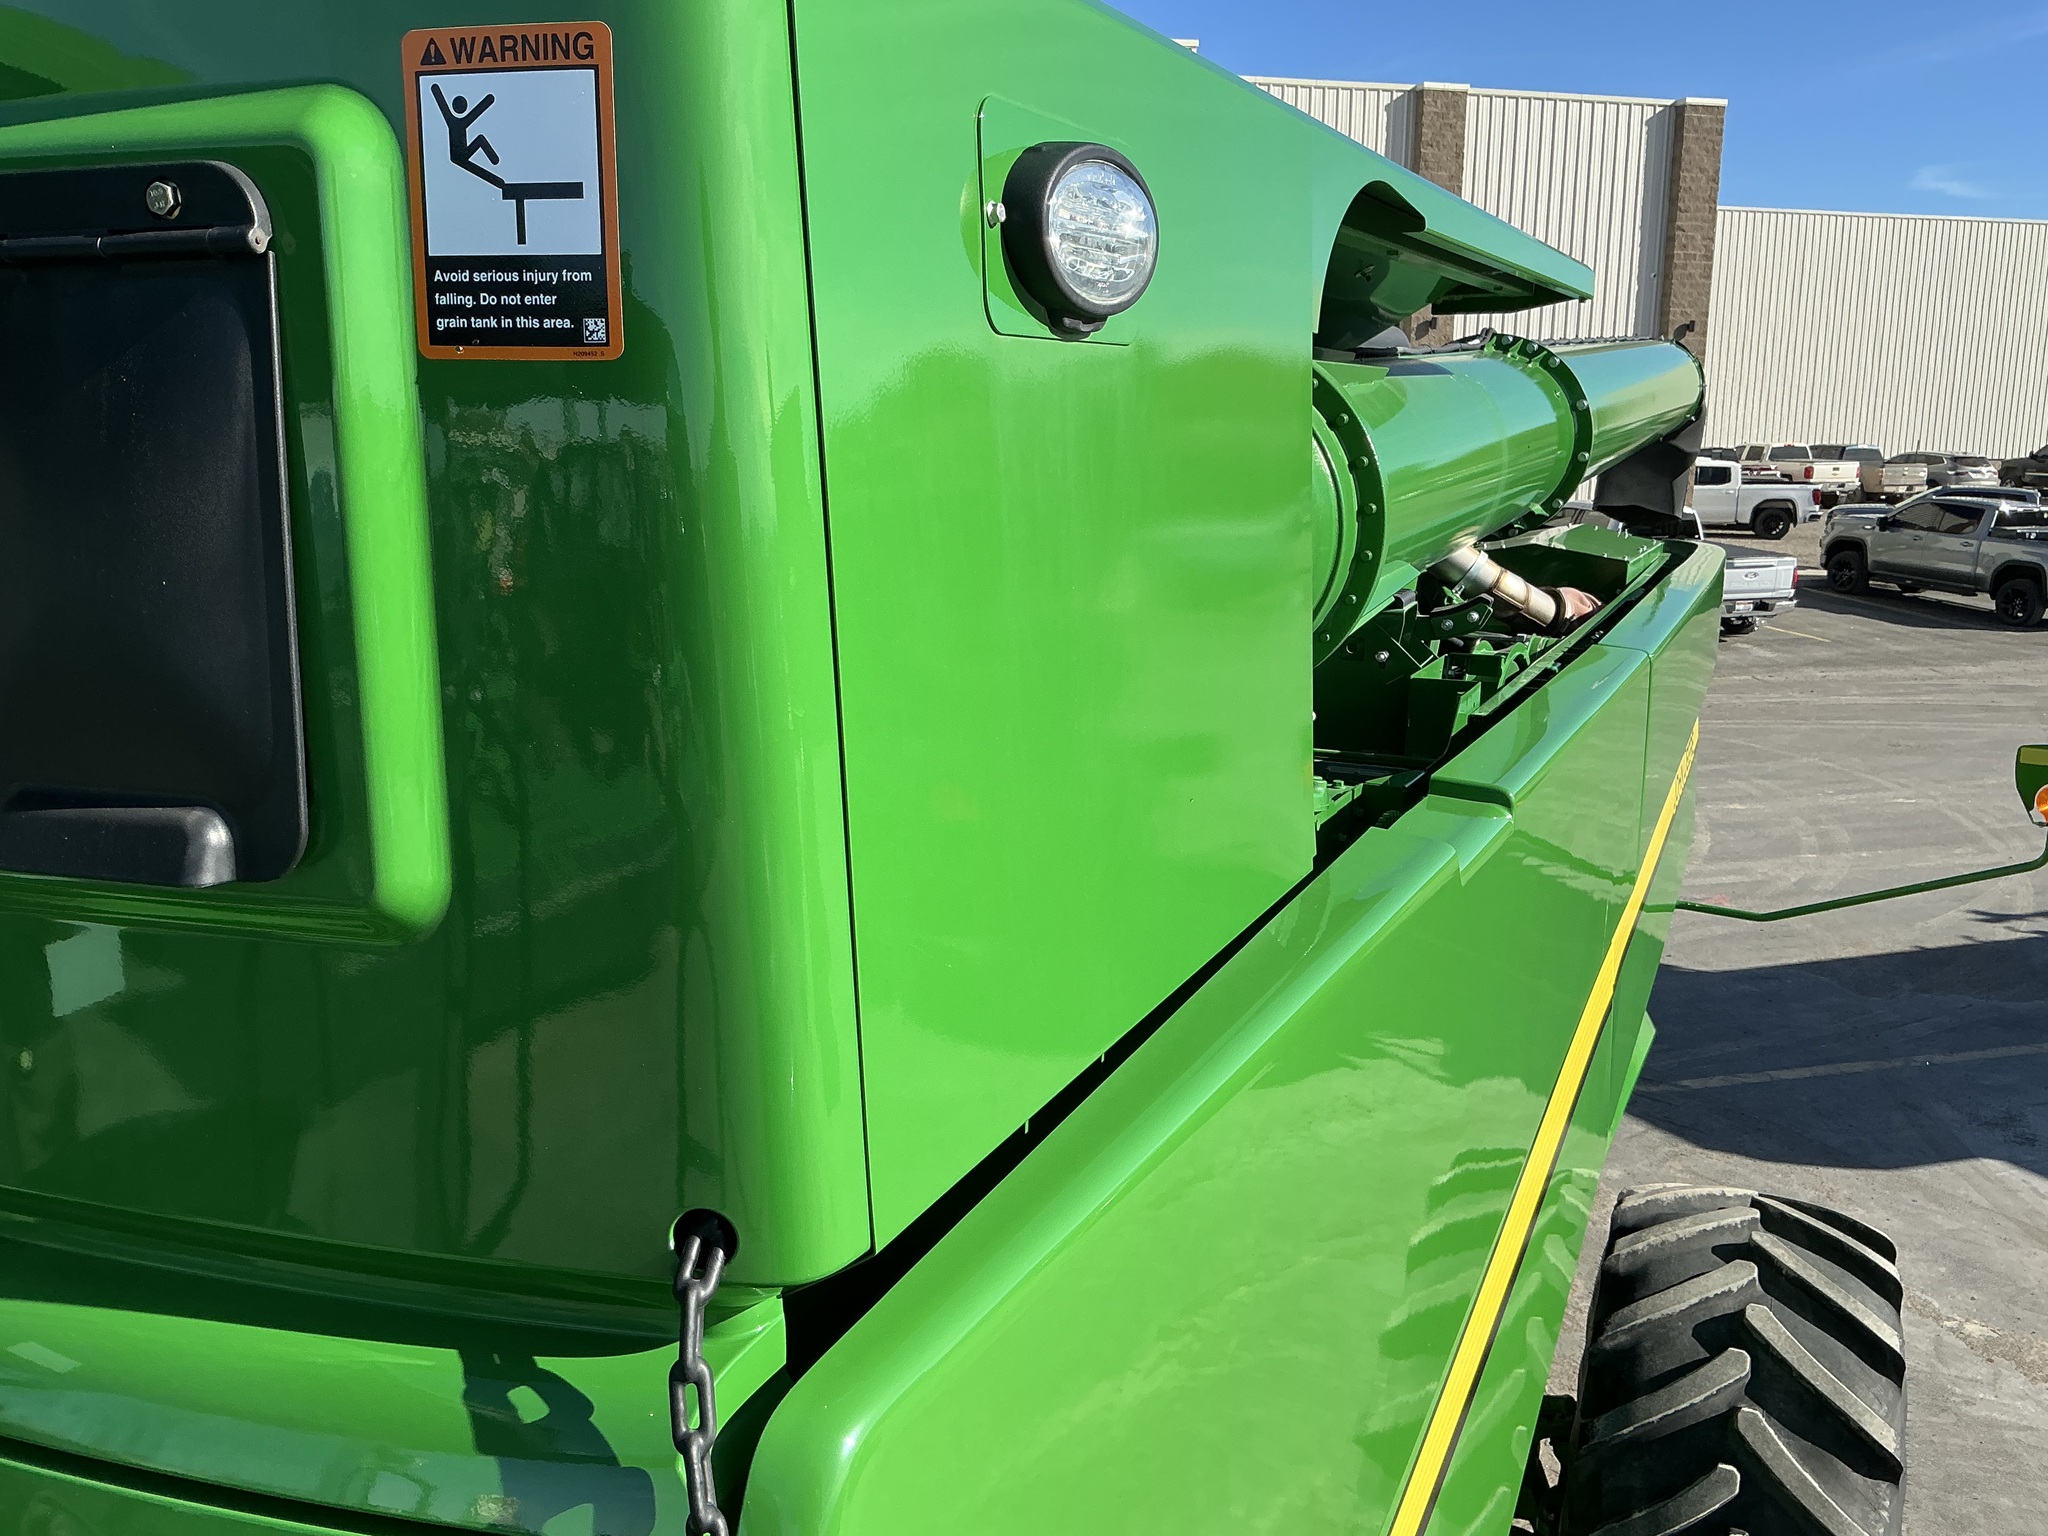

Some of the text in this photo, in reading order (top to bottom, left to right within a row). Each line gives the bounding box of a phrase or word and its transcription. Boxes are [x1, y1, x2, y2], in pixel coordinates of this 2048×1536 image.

[450, 32, 594, 64] WARNING
[434, 269, 593, 285] Avoid serious injury from
[435, 293, 558, 308] falling. Do not enter
[436, 315, 574, 331] grain tank in this area.
